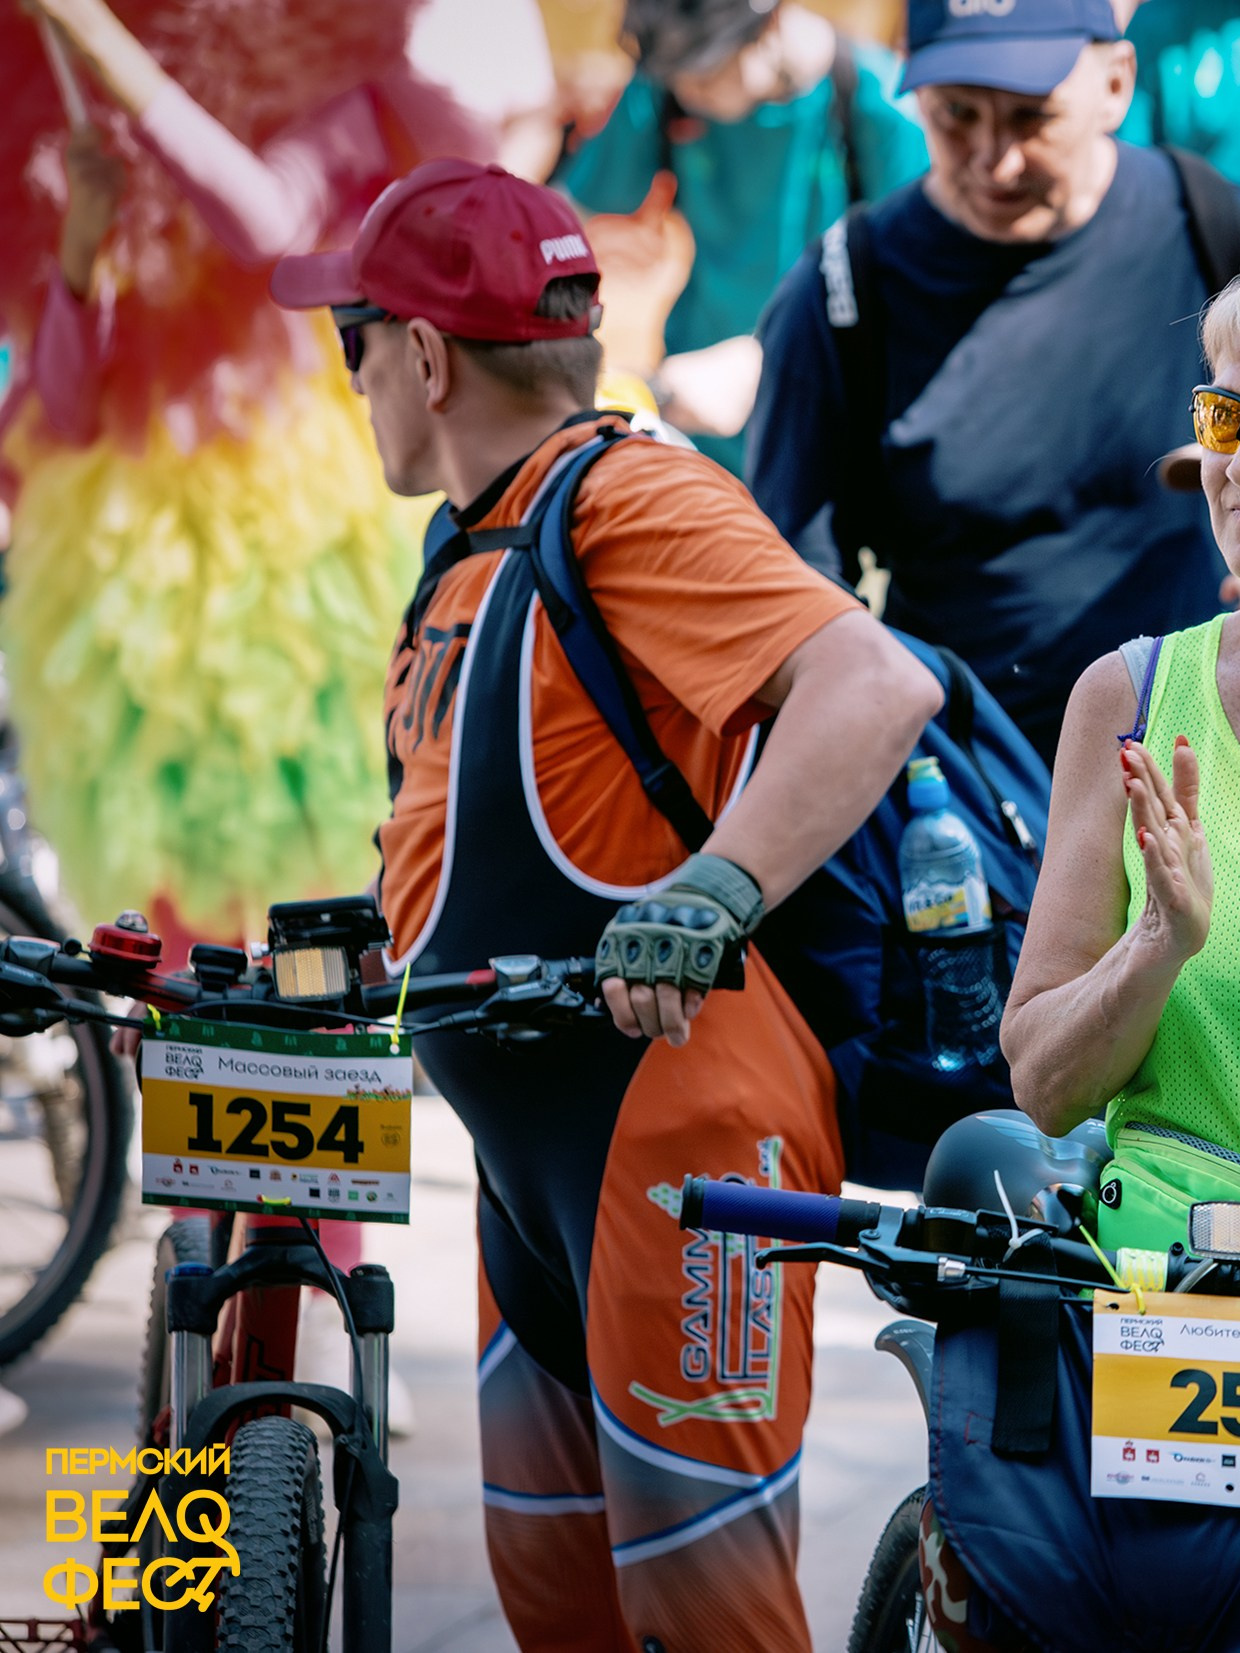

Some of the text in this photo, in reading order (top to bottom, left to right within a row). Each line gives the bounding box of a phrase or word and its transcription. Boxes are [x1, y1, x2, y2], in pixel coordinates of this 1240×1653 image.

[218, 1056, 382, 1084] Массовый заезд
[188, 1091, 364, 1164] 1254
